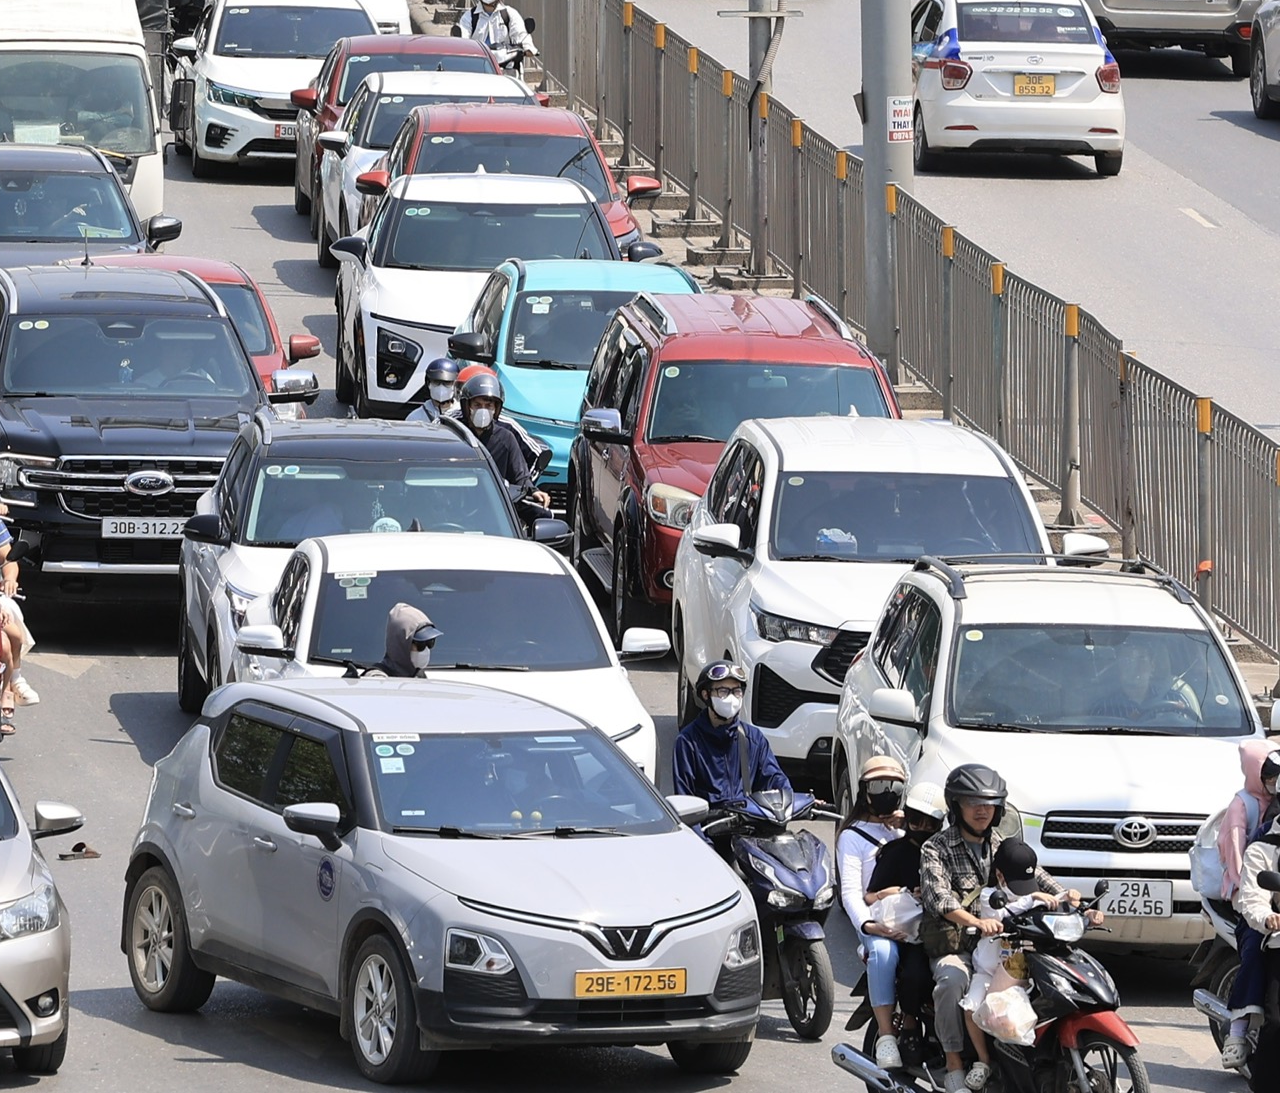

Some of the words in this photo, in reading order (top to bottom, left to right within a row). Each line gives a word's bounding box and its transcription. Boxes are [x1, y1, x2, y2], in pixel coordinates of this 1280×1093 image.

[1026, 76, 1044, 85] 30E
[1018, 86, 1051, 95] 859.32
[137, 477, 162, 488] Ford
[1120, 882, 1151, 898] 29A
[1106, 899, 1164, 916] 464.56
[584, 974, 678, 994] 29E-172.56
